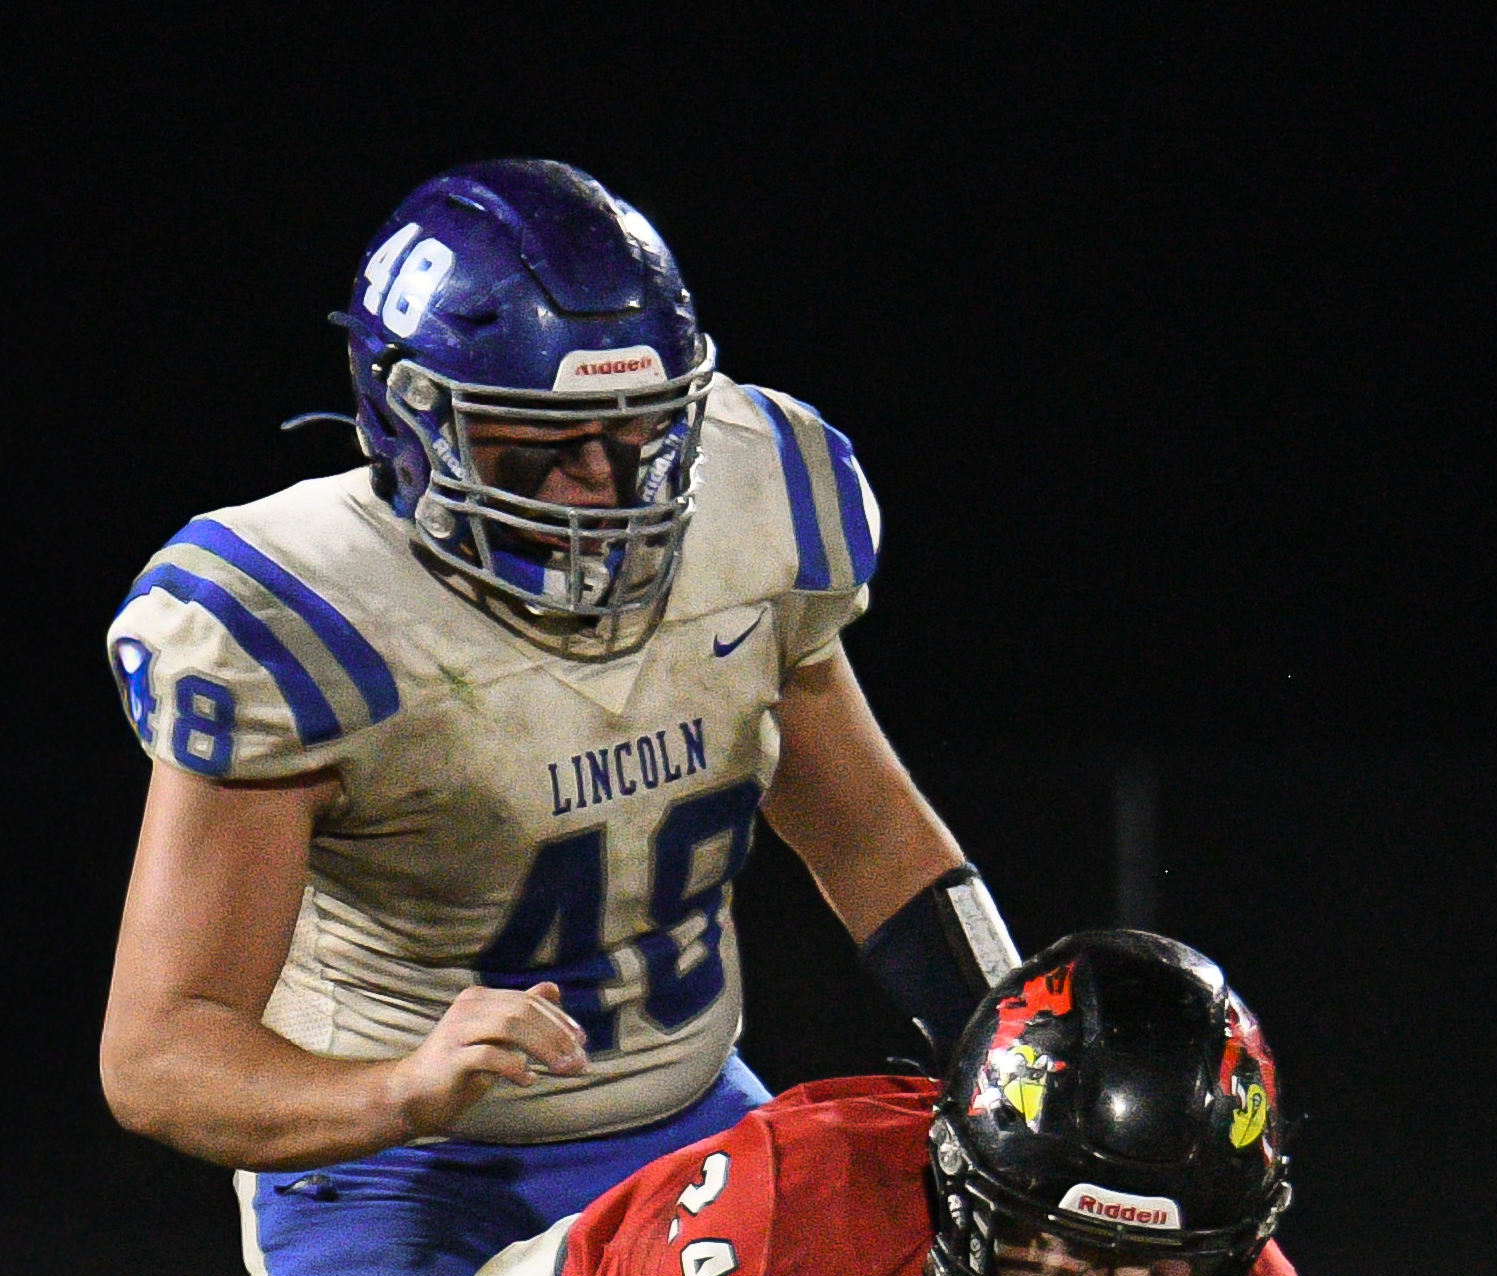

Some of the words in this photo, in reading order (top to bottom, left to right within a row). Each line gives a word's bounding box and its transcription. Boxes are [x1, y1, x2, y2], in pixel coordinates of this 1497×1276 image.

[362, 222, 456, 339] 48
[113, 636, 237, 776] 48
[547, 717, 707, 817] LINCOLN
[478, 777, 764, 1055] 48
[1078, 1194, 1168, 1225] Riddell
